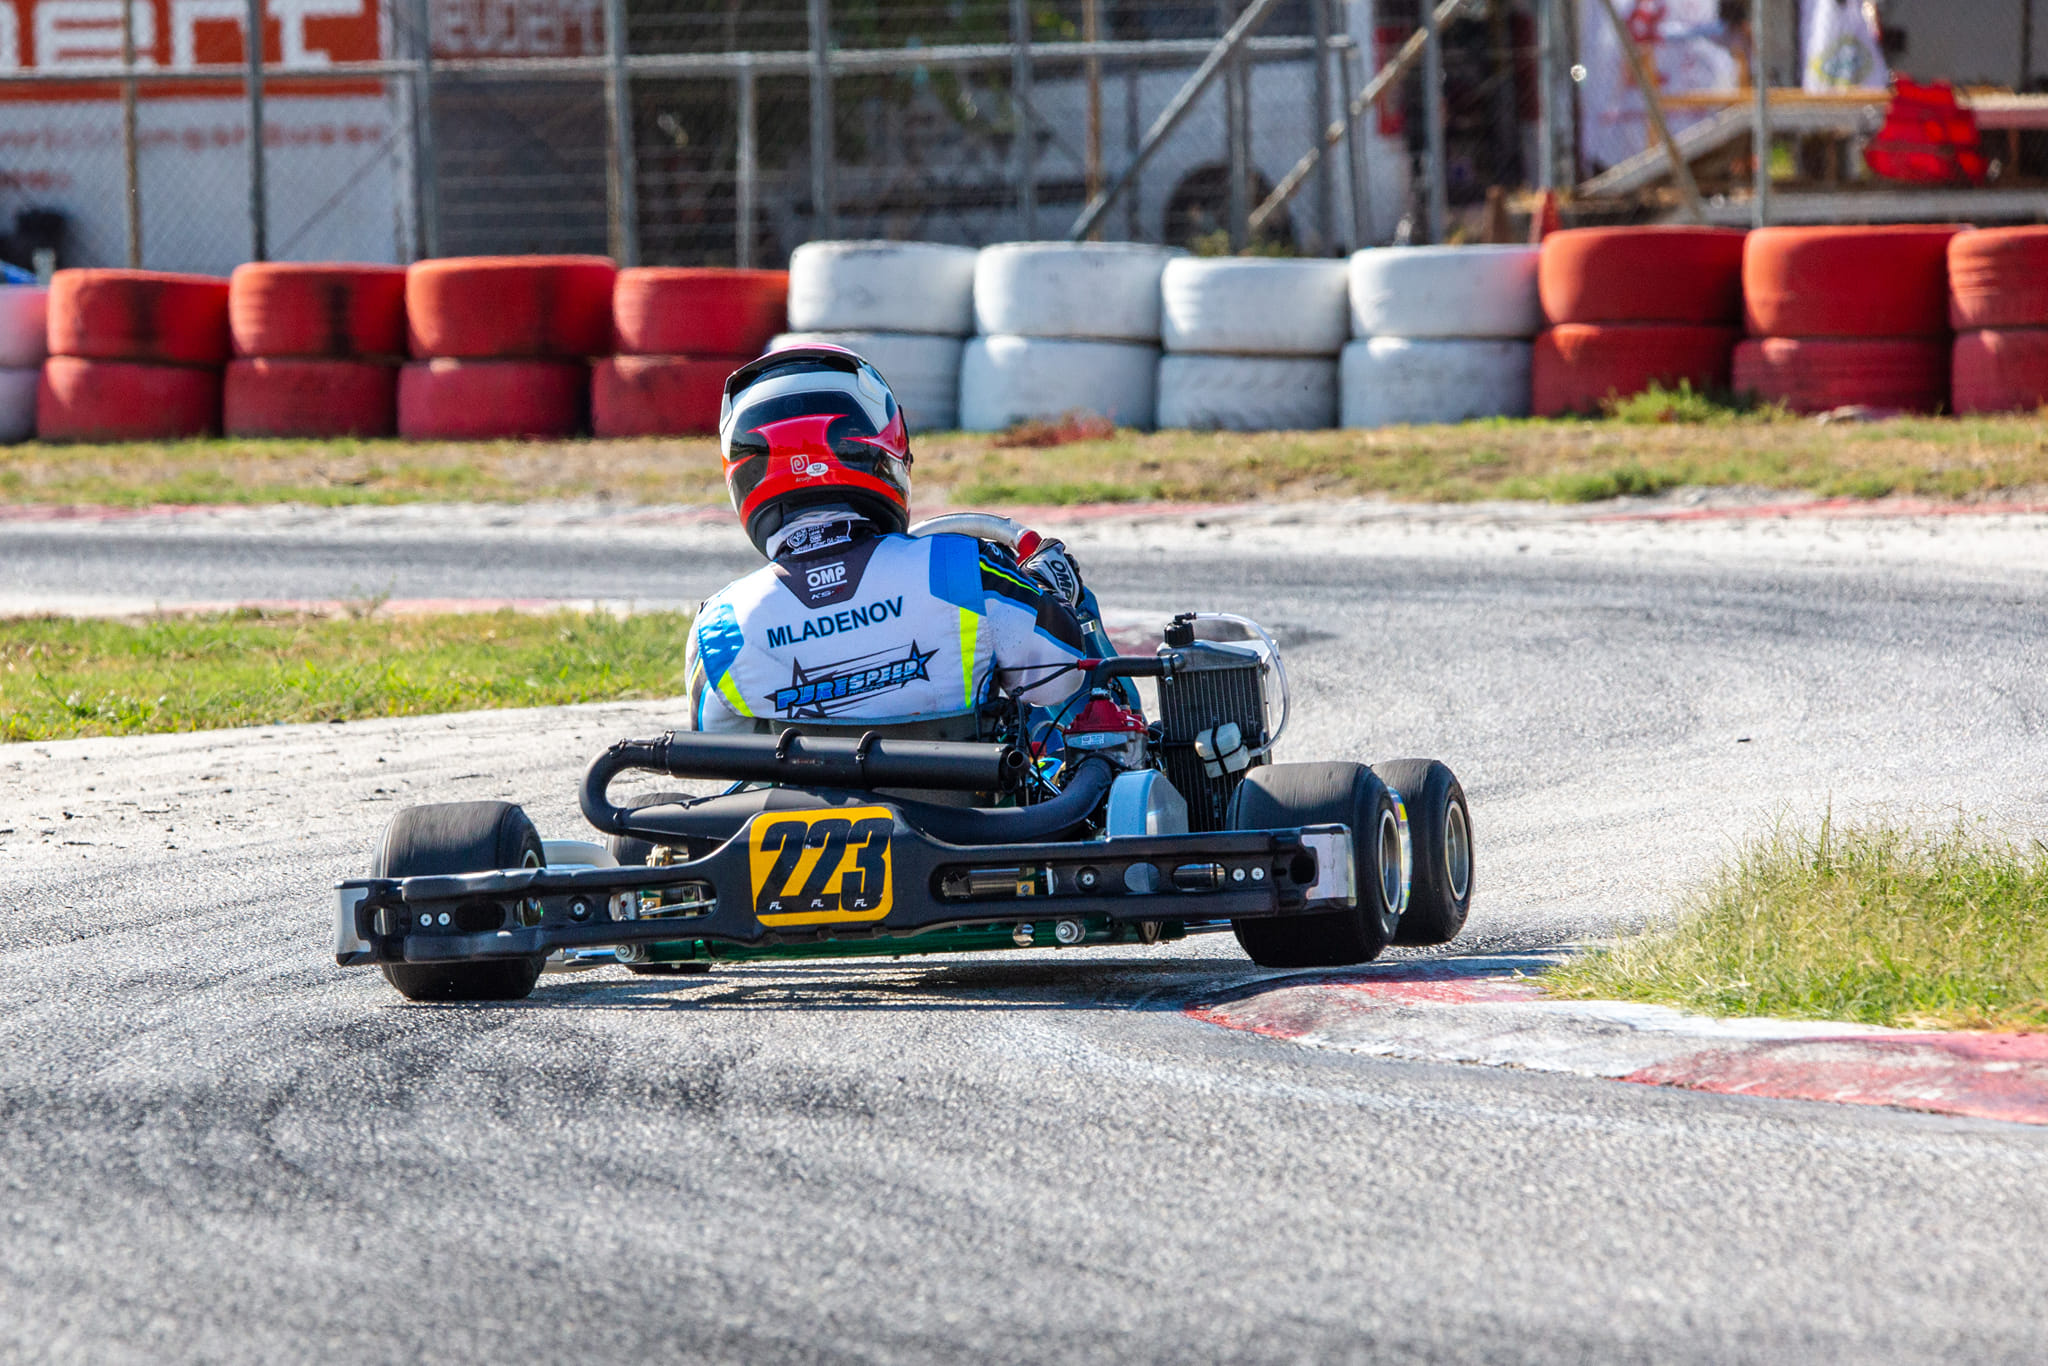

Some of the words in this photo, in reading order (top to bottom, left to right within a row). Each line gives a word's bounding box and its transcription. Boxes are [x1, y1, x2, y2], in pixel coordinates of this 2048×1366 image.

[0, 0, 366, 75] ent
[807, 566, 846, 587] OMP
[1050, 560, 1073, 601] OMP
[766, 595, 903, 649] MLADENOV
[756, 817, 895, 916] 223
